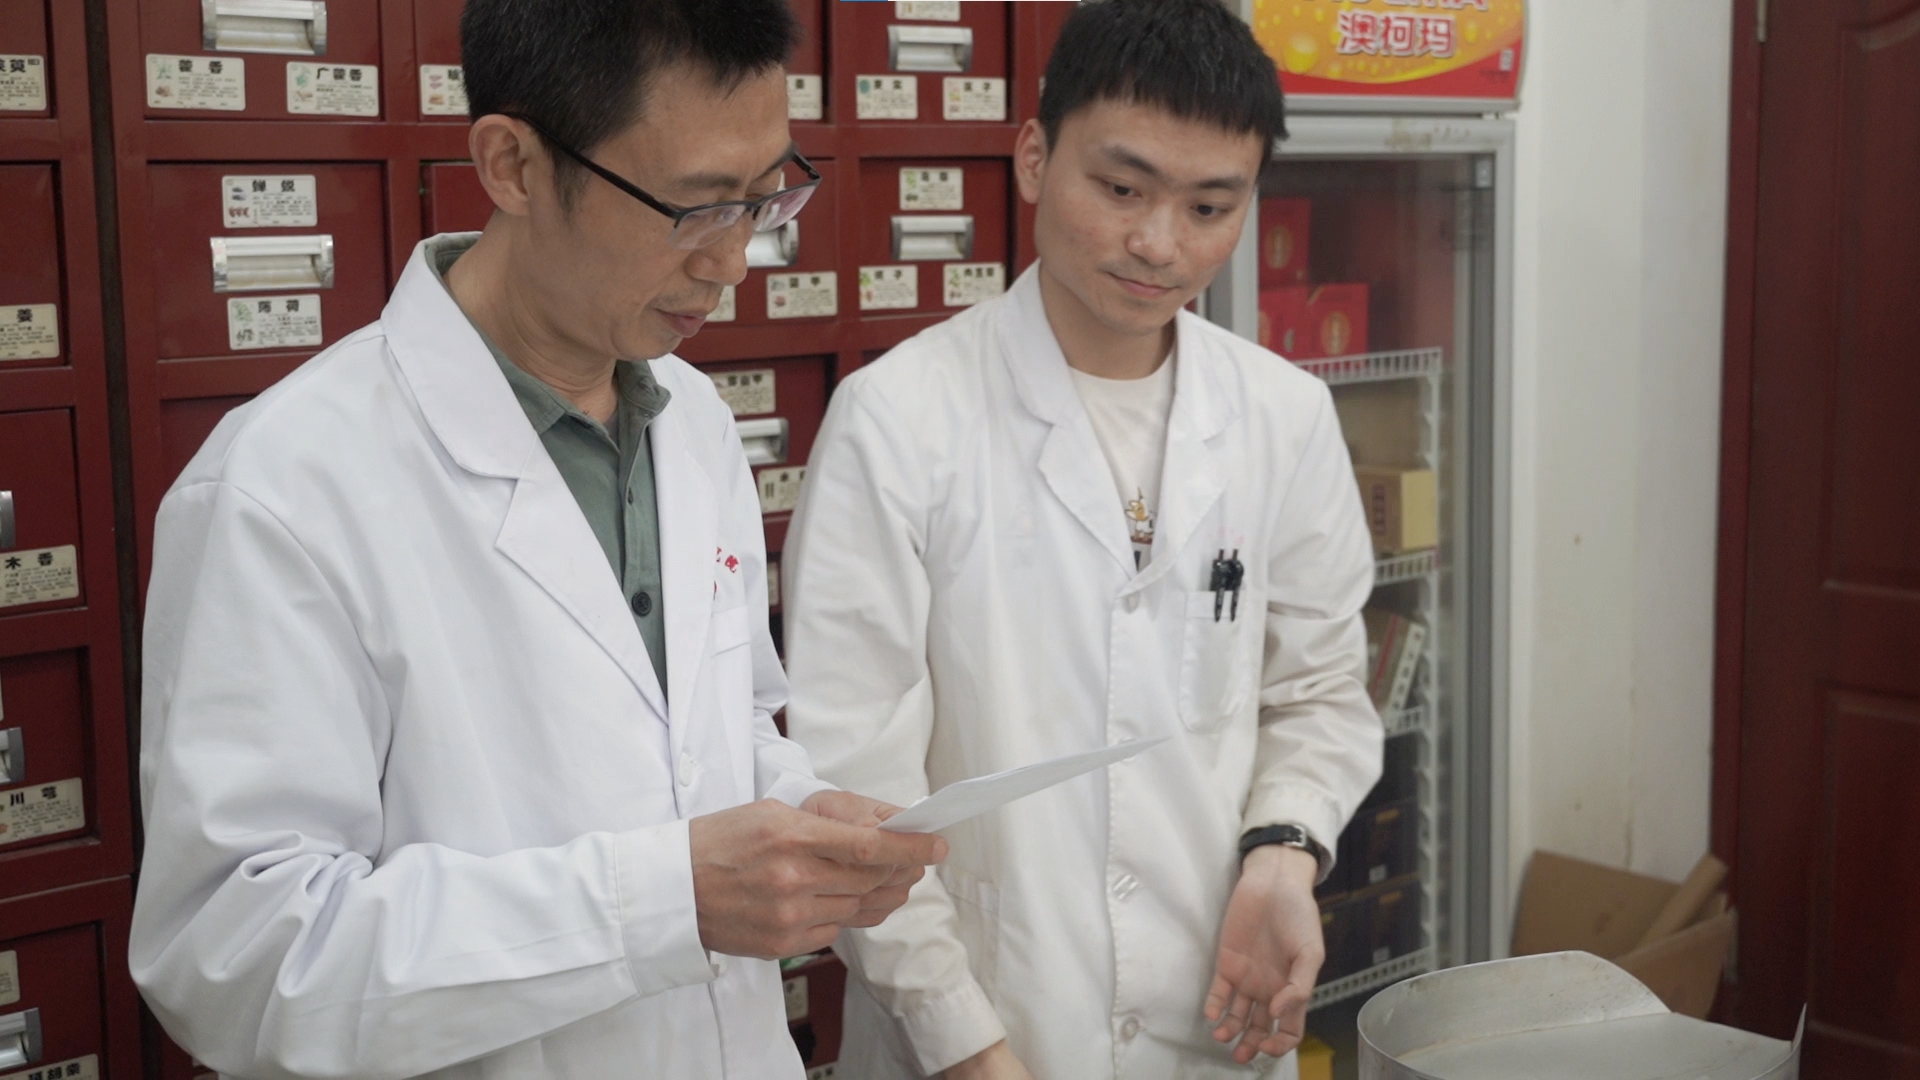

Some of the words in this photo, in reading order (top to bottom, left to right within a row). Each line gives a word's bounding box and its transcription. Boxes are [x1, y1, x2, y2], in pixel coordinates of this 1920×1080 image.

[1338, 11, 1453, 56] 澳柯玛
[178, 59, 224, 75] 藿香
[316, 67, 363, 82] 广藿香
[5, 552, 53, 570] 木香
[10, 785, 57, 806] 川芎
